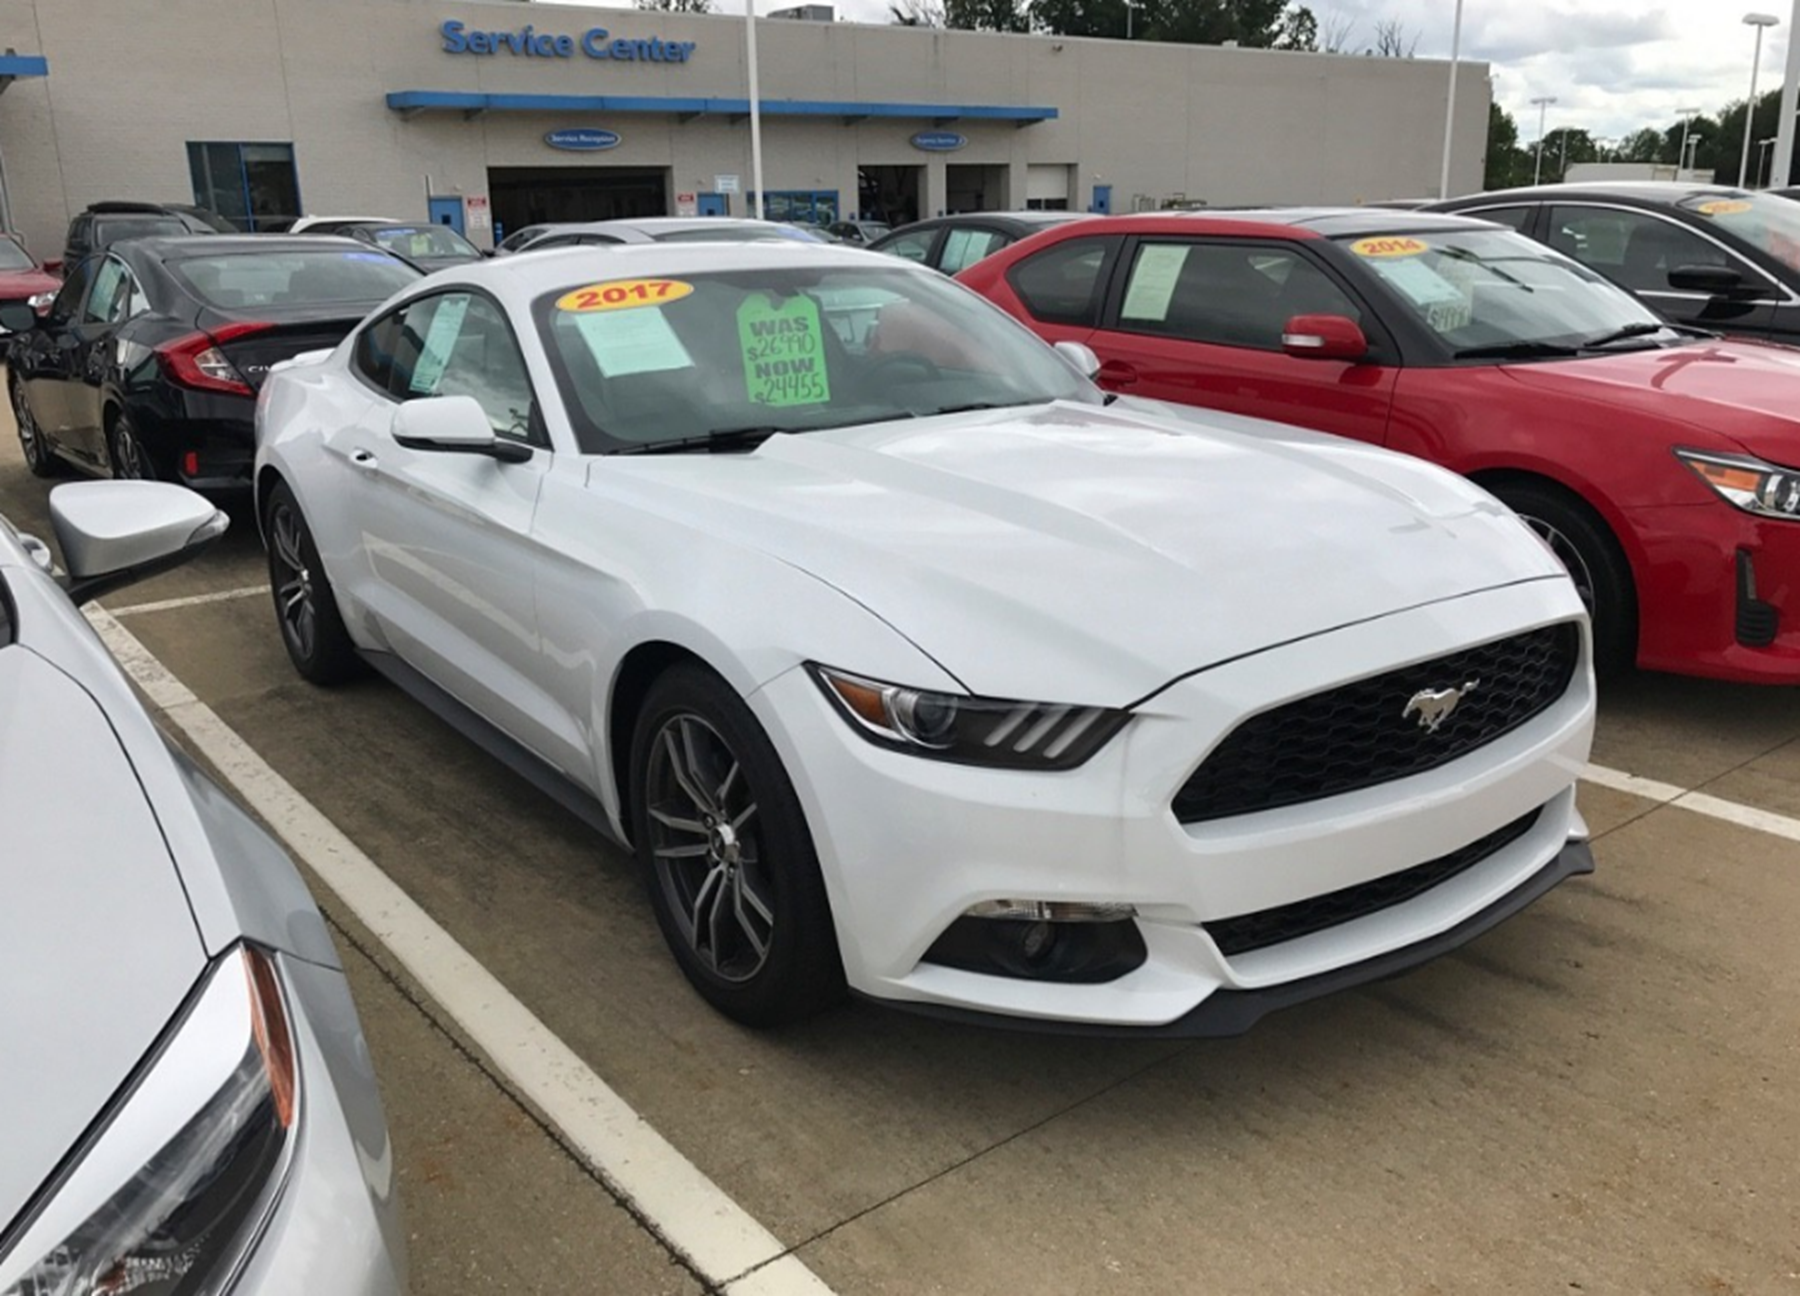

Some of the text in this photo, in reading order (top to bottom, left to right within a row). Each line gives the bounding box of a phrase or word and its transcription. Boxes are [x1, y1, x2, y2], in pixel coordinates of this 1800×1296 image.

[440, 19, 696, 63] Service Center
[551, 134, 578, 143] Service
[1362, 239, 1422, 254] 2014
[576, 282, 673, 309] 2017
[749, 316, 809, 337] WAS
[755, 357, 815, 379] NOW
[754, 372, 825, 404] $24455
